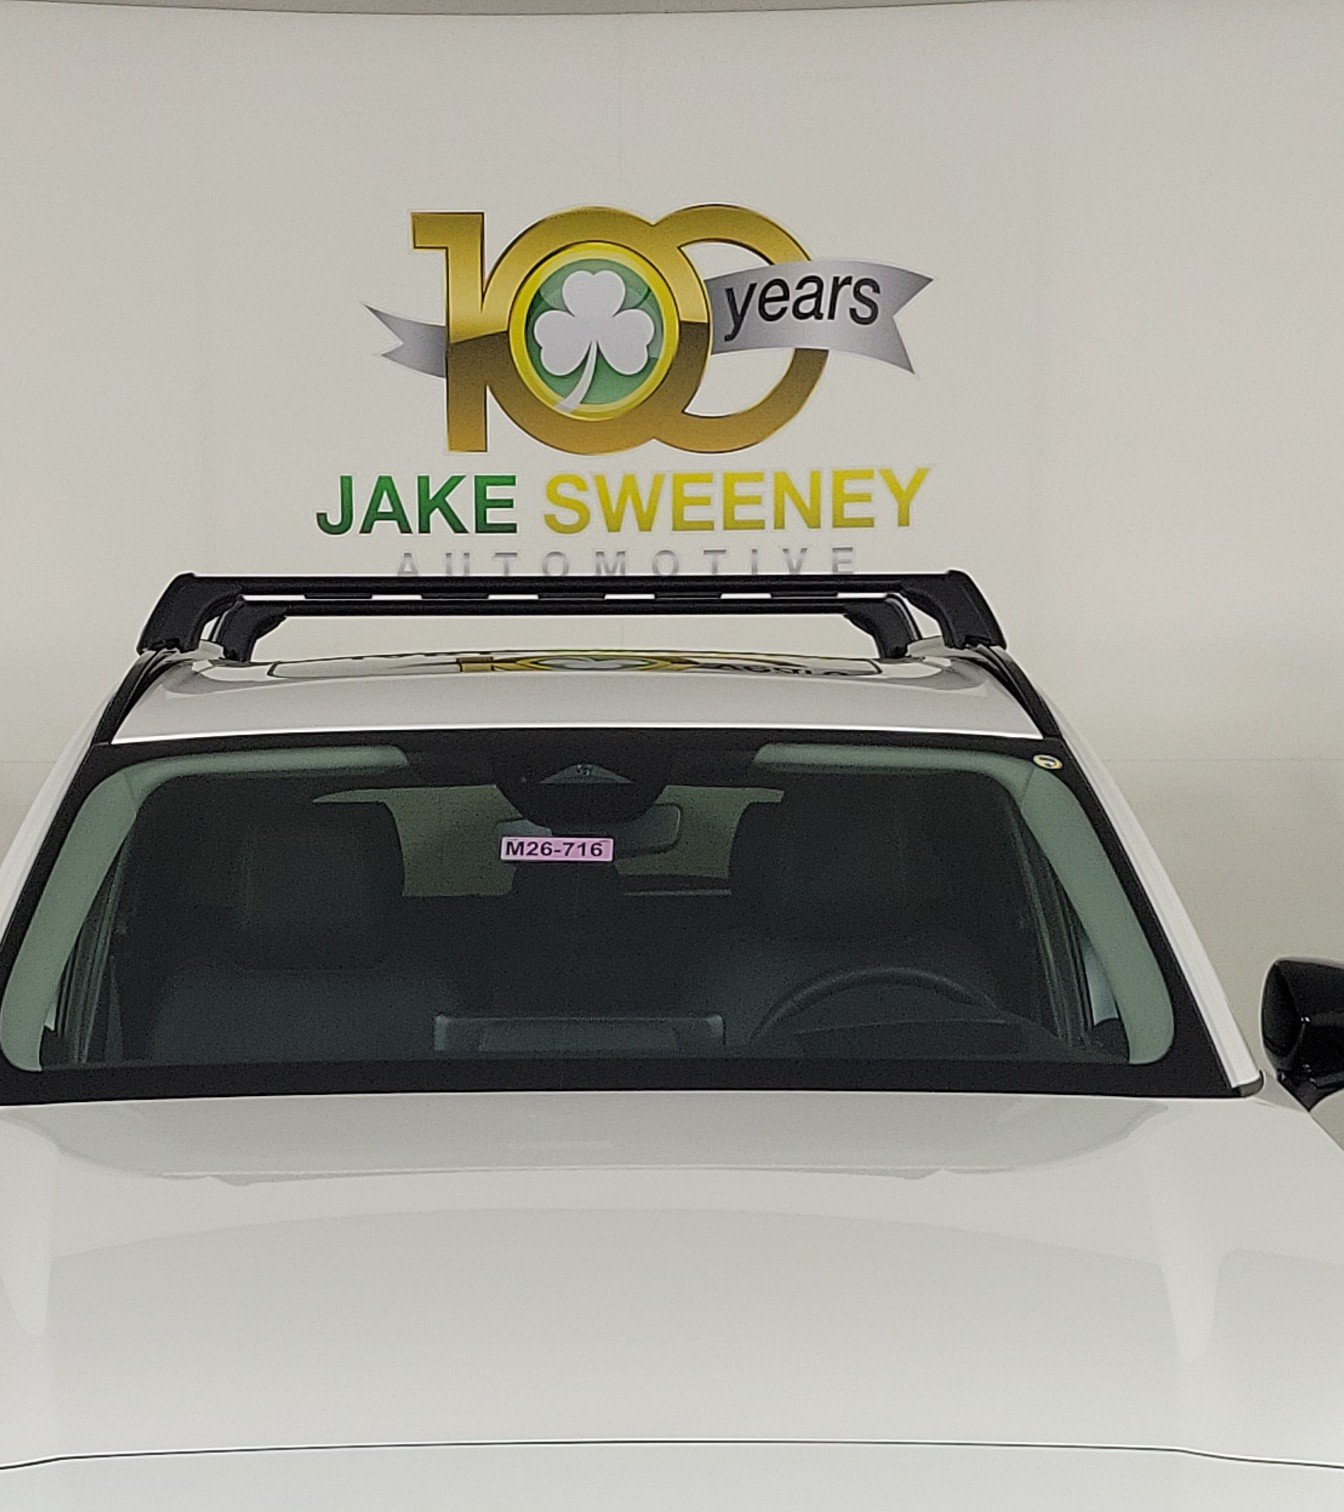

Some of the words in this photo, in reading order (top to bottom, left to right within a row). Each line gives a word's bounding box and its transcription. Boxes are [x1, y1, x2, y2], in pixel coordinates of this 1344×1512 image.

[411, 204, 829, 455] 100
[724, 273, 881, 341] years
[316, 474, 518, 535] JAKE
[544, 467, 929, 534] SWEENEY
[397, 547, 855, 576] AUTOMOTIVE
[505, 841, 603, 857] M26-716
